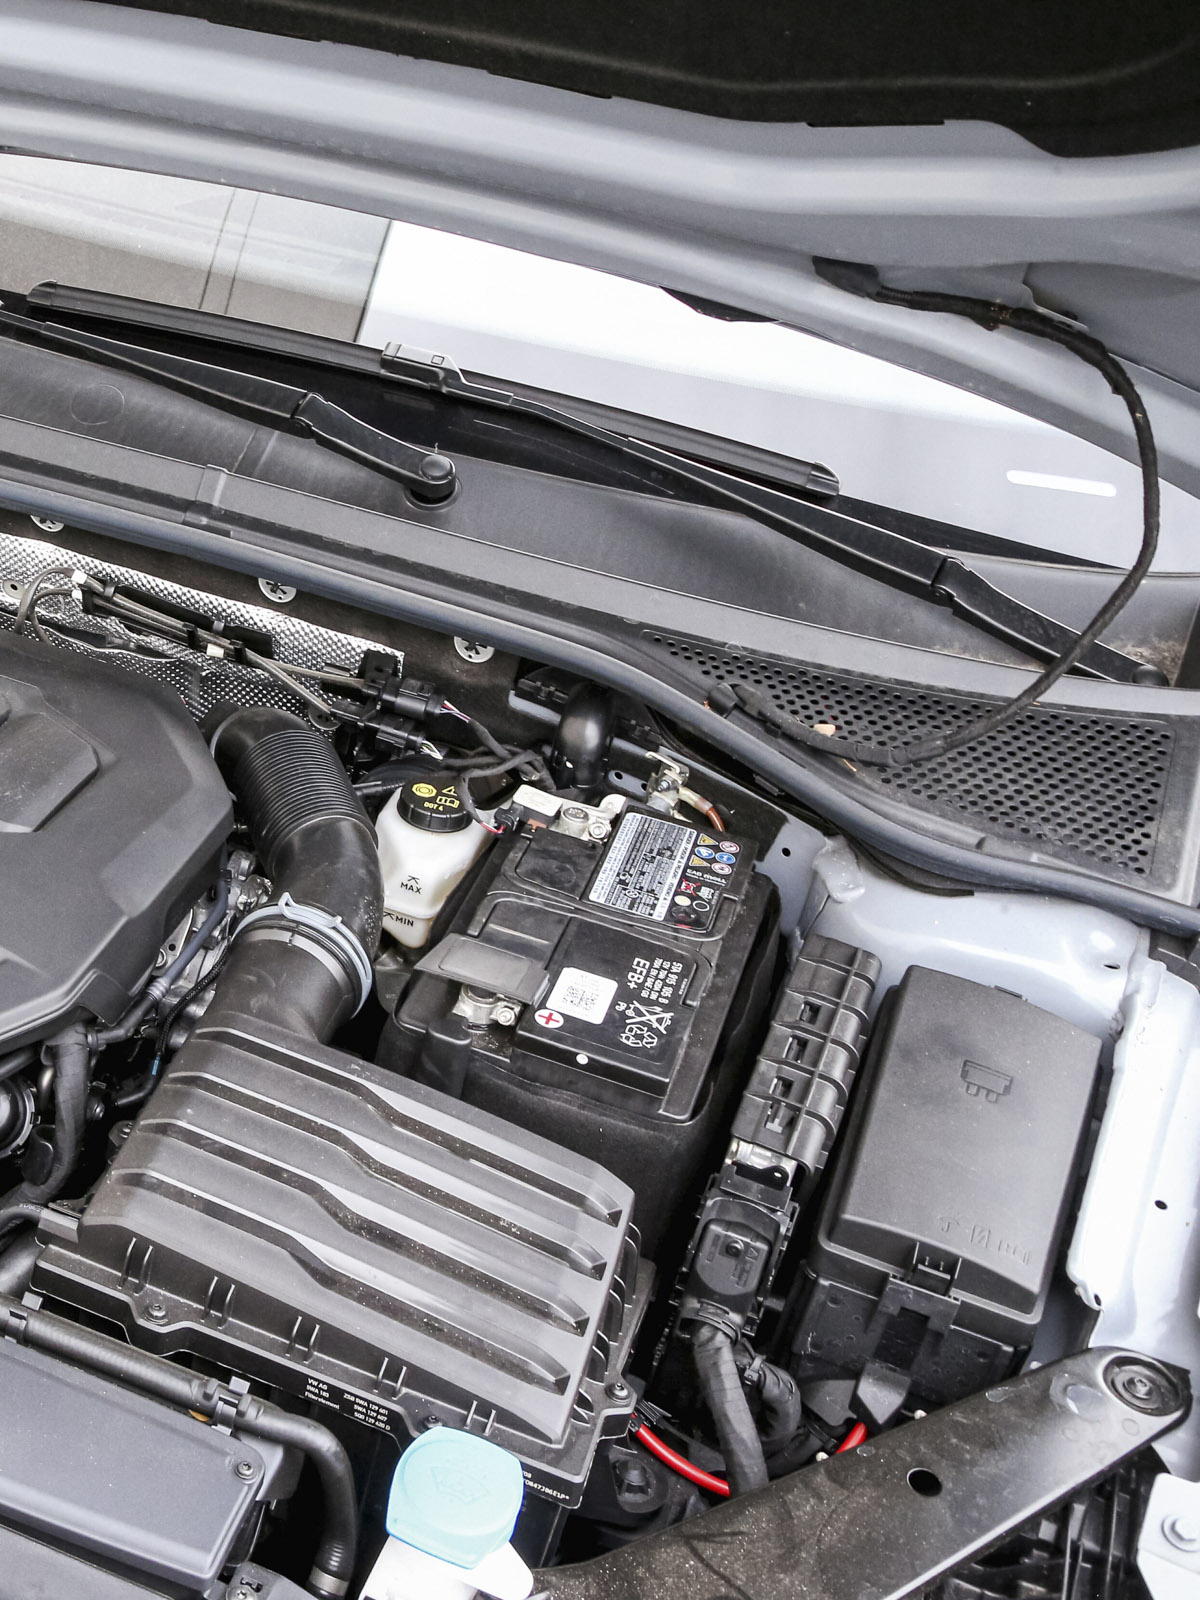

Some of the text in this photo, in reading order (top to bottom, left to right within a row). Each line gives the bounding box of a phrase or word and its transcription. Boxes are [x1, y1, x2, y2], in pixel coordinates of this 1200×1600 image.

[424, 801, 438, 810] DOT
[400, 882, 422, 895] MAX
[395, 915, 414, 927] MIN
[627, 958, 650, 989] EFB+
[666, 974, 678, 986] 915
[615, 1000, 627, 1012] Pb
[308, 1378, 328, 1390] VW AG
